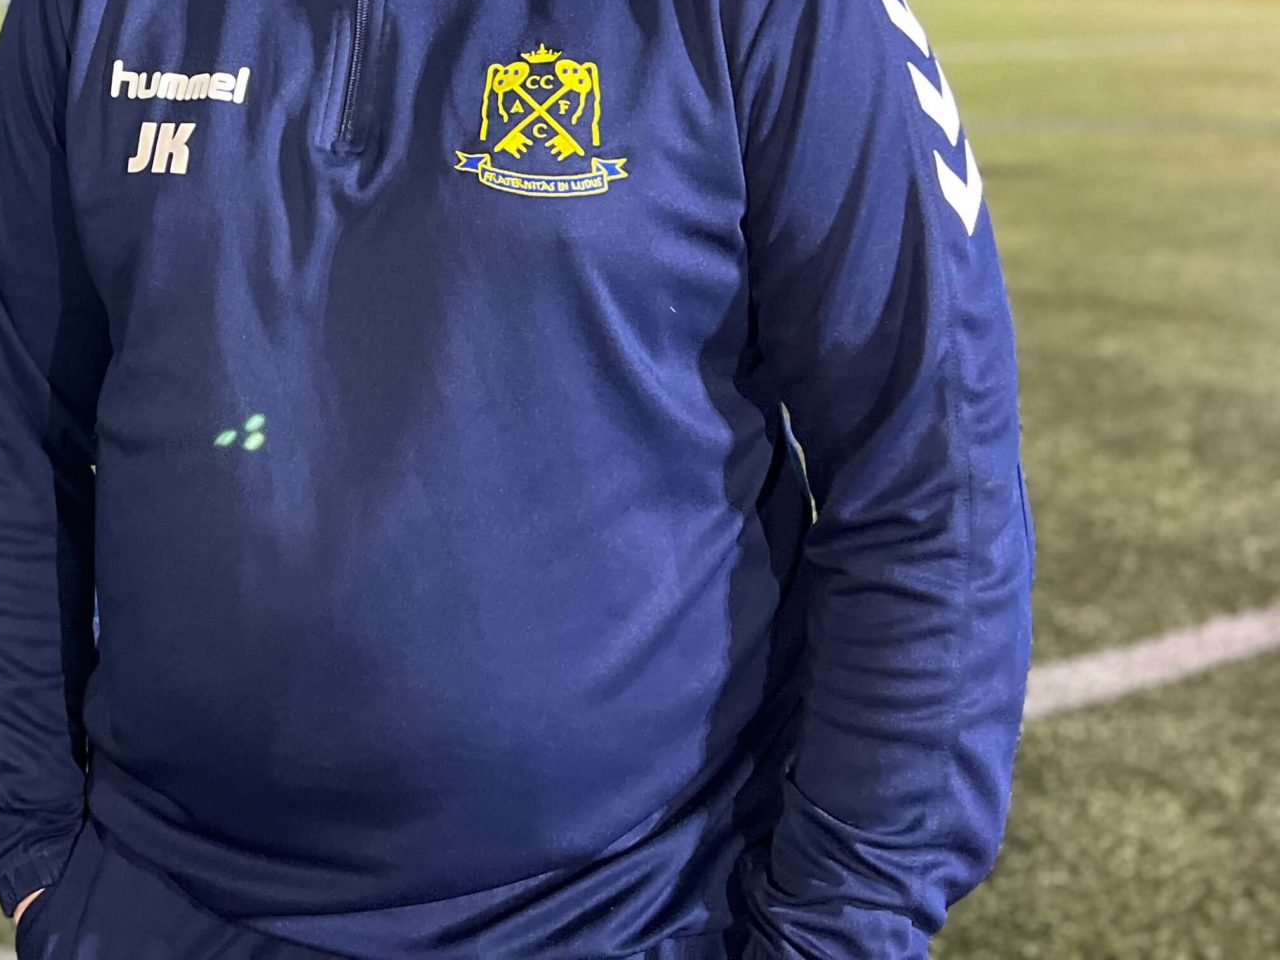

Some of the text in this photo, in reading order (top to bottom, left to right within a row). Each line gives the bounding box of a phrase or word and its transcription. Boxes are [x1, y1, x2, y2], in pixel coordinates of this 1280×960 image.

[110, 59, 251, 104] hummel
[525, 75, 554, 89] CC
[509, 99, 570, 115] A F
[532, 123, 548, 138] C
[127, 122, 196, 175] JK
